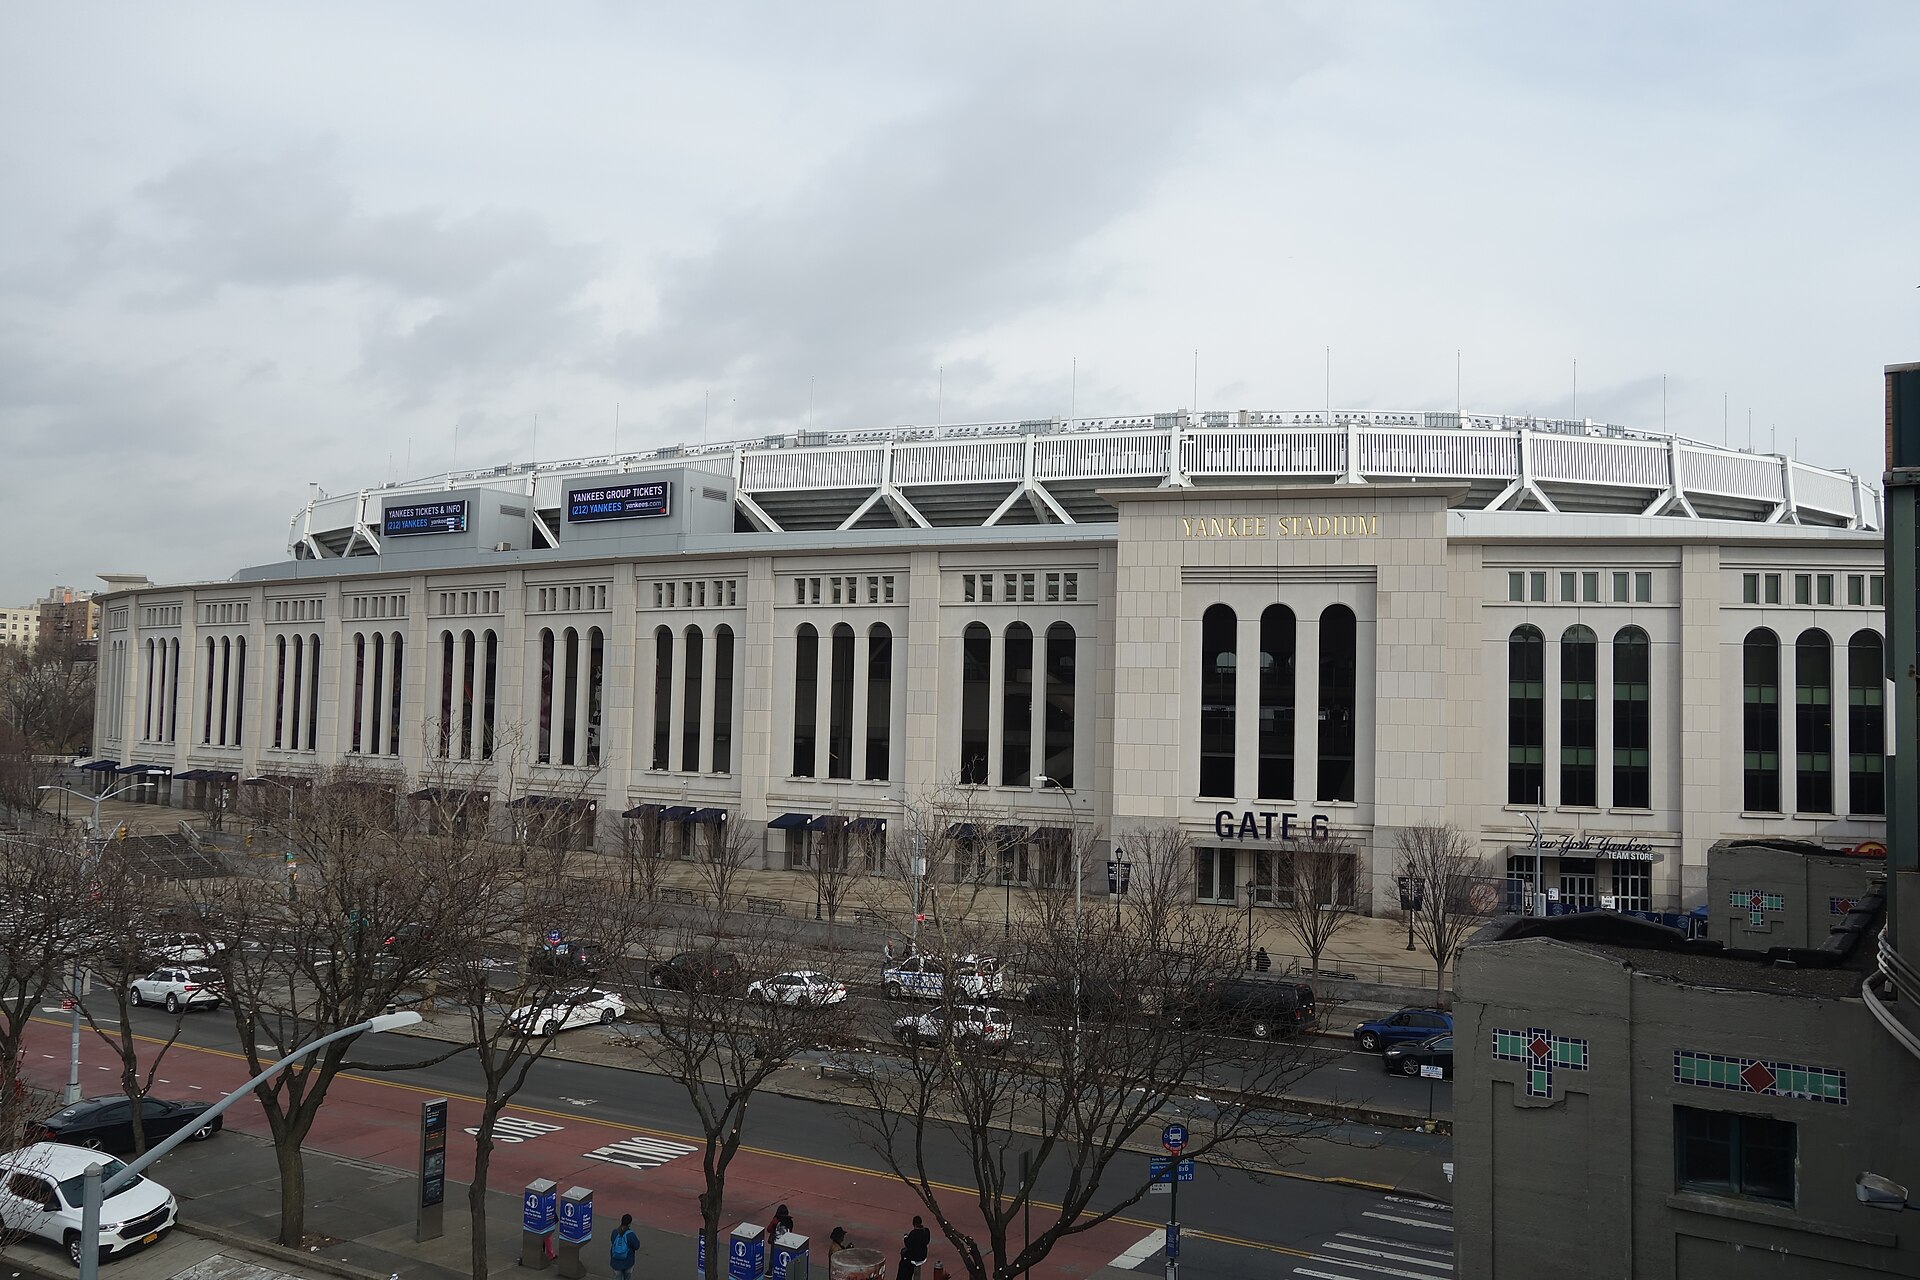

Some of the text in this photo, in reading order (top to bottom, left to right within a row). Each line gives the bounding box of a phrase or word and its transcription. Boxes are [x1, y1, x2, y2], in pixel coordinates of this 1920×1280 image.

[573, 486, 663, 502] YANKEES GROUP TICKETS
[388, 504, 461, 518] YANKEES TICKETS & INFO
[572, 501, 662, 516] (212) YANKEES yankees.com
[387, 520, 401, 531] (212)
[401, 519, 428, 529] YANKEES
[1181, 515, 1379, 537] YANKEE STADIUM
[1215, 810, 1329, 841] GATE 6
[1526, 833, 1653, 858] New York Yankees
[1607, 851, 1654, 861] TEAM STORE
